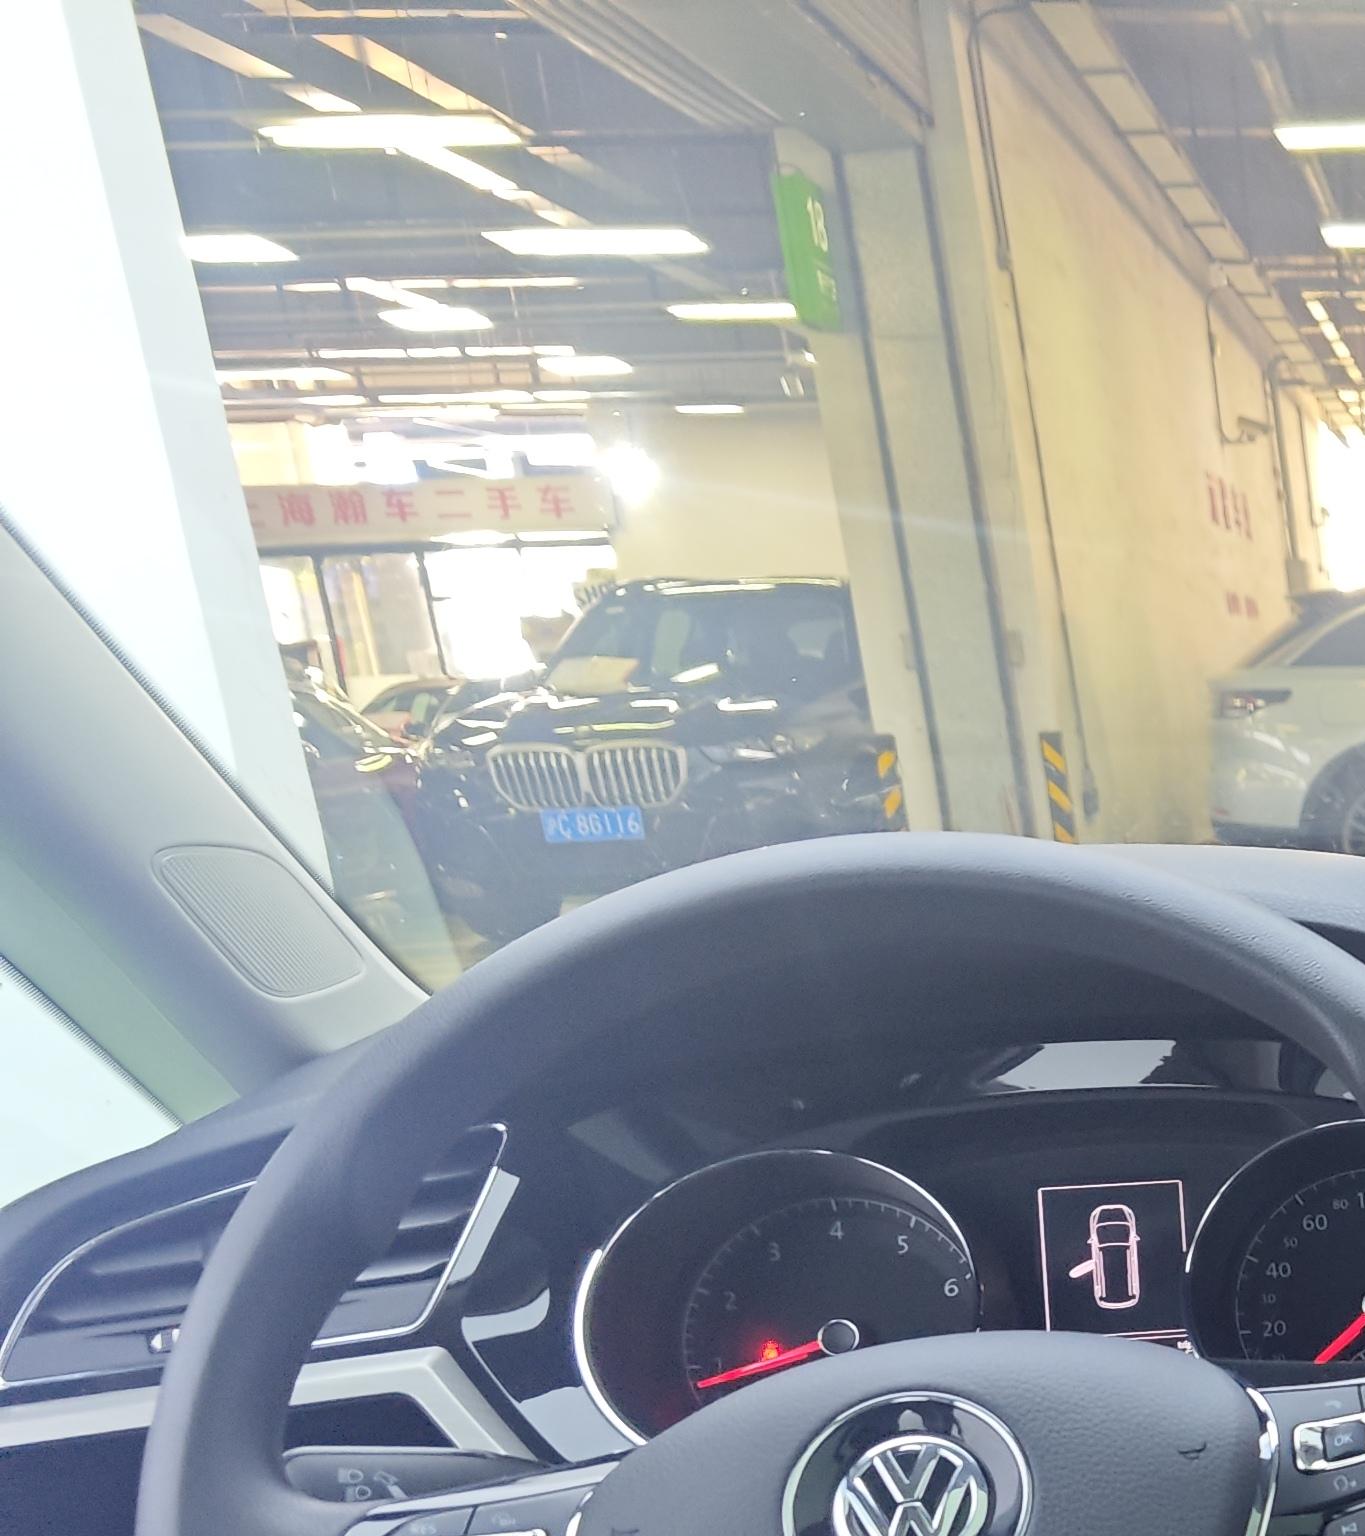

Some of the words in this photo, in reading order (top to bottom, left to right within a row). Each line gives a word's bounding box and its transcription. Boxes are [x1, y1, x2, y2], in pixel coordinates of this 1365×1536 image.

[1332, 1199, 1349, 1211] 80
[829, 1220, 845, 1241] 4
[1302, 1214, 1328, 1232] 60
[767, 1243, 781, 1262] 3
[897, 1235, 910, 1255] 5
[1265, 1262, 1292, 1280] 40
[943, 1278, 959, 1298] 6
[1262, 1319, 1287, 1338] 20
[1333, 1432, 1354, 1447] OK
